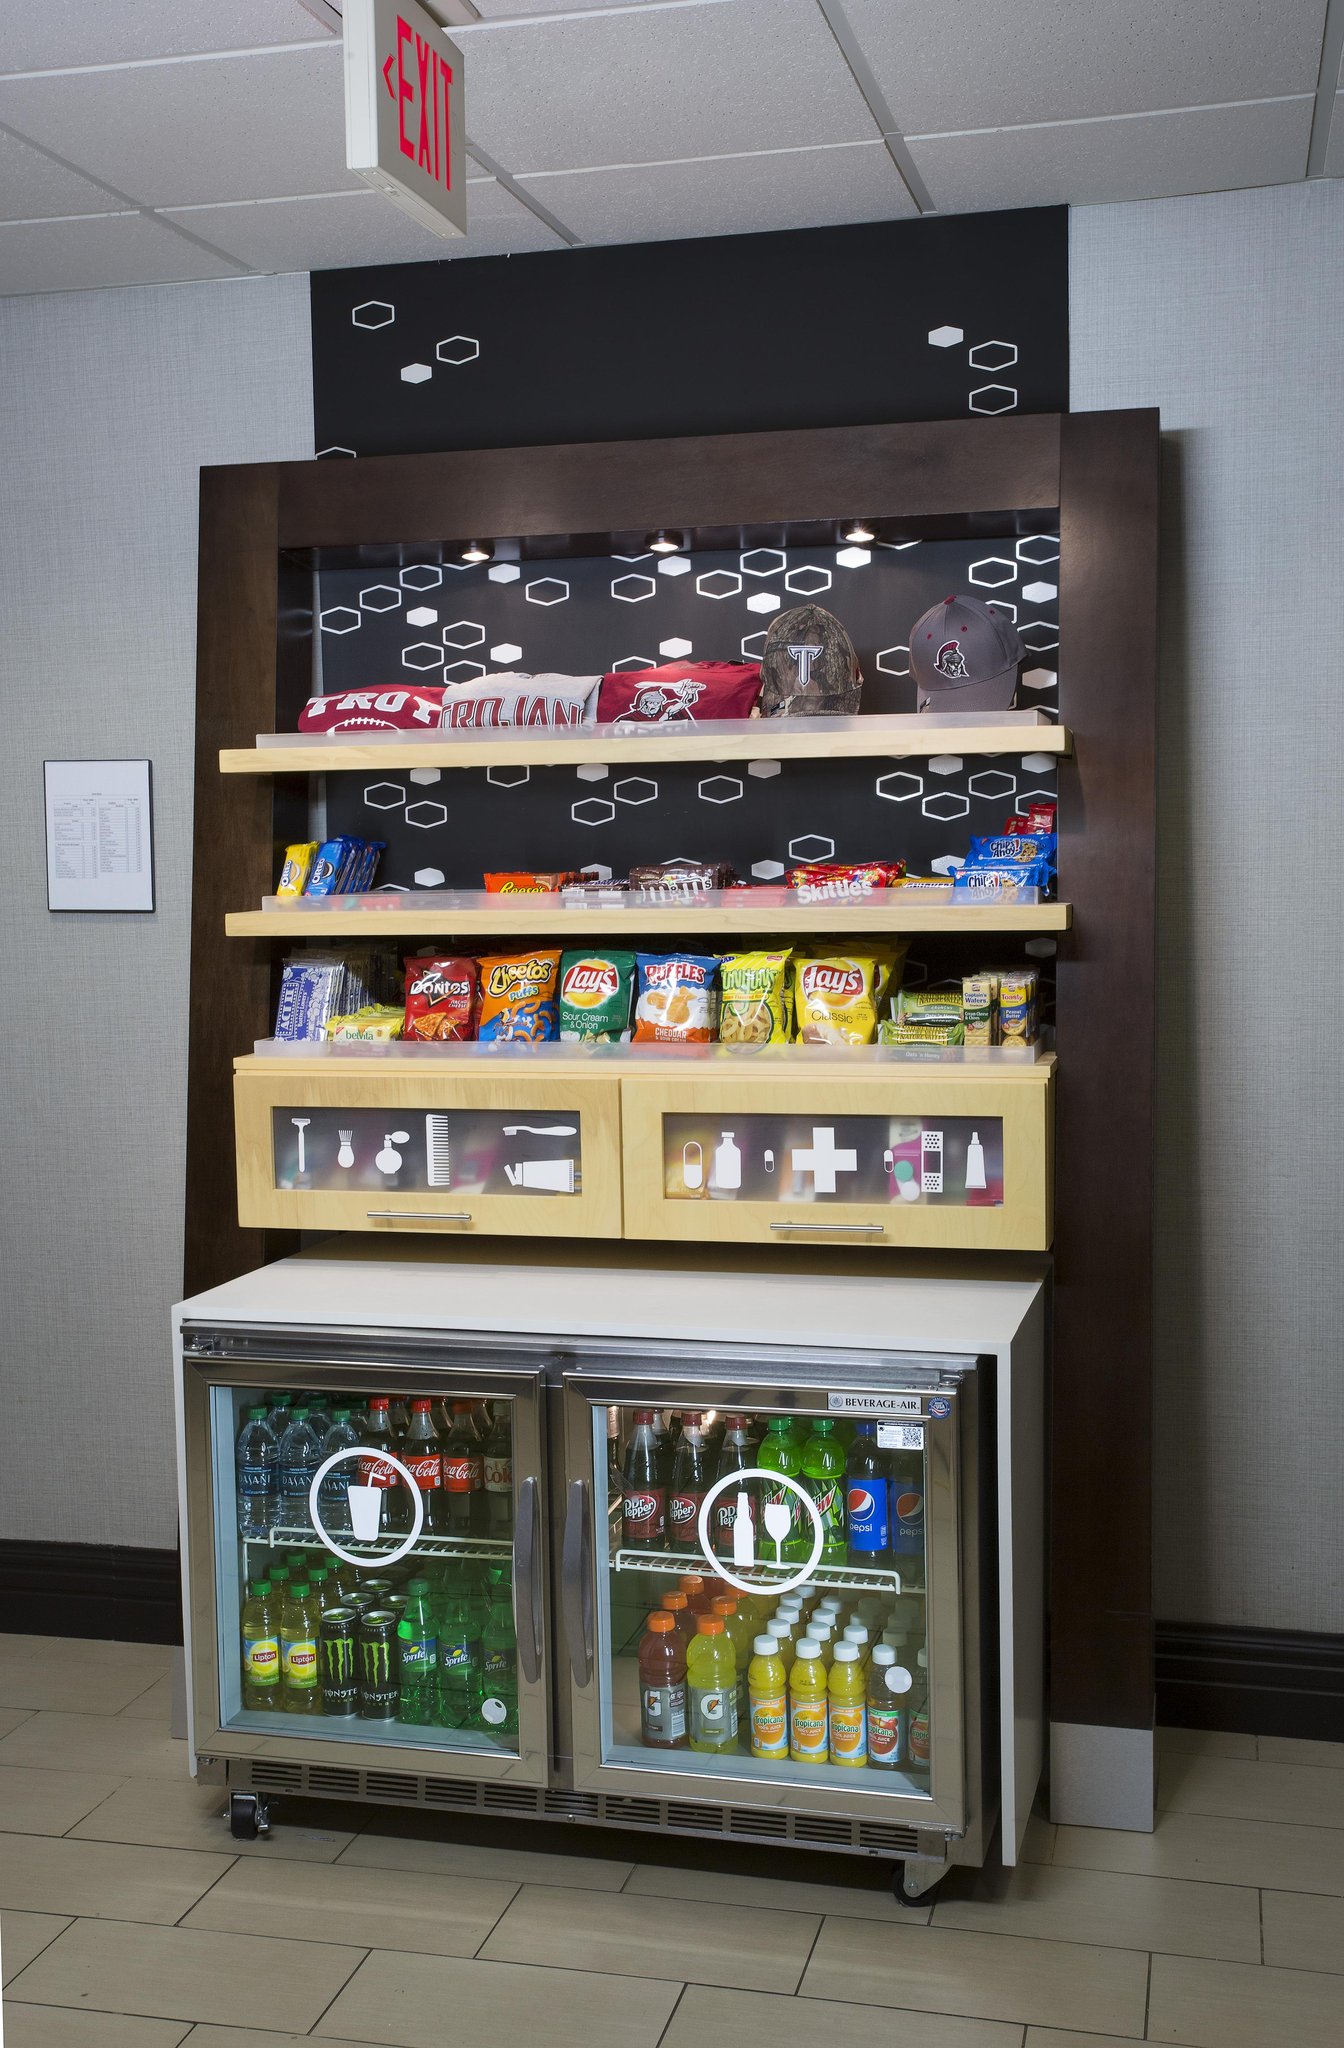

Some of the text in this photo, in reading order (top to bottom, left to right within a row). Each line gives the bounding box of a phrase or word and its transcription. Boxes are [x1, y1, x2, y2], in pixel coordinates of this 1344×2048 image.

[397, 15, 453, 192] EXIT
[305, 691, 442, 724] TROY
[991, 841, 1015, 851] Chips
[281, 860, 292, 887] OREO
[312, 858, 325, 884] OREO
[797, 880, 873, 904] Skittles
[489, 959, 551, 996] Cheetos
[645, 962, 706, 985] RUFFLES
[565, 967, 615, 993] Lay's
[805, 966, 860, 994] Lay's
[410, 979, 470, 995] Doritos
[509, 986, 538, 1001] Puffs
[281, 1005, 292, 1030] ACT
[562, 1012, 609, 1023] Sour Cream
[811, 1010, 853, 1024] Classic
[570, 1020, 599, 1029] & Onion
[346, 1030, 374, 1040] belvita
[655, 1027, 687, 1039] CHEDDAR
[402, 1459, 440, 1477] ca-Cola
[283, 1475, 313, 1486] DASAN
[322, 1479, 350, 1491] ASANI
[624, 1500, 654, 1519] Pepper
[850, 1523, 873, 1533] pepsi
[900, 1528, 923, 1537] peps
[254, 1652, 276, 1662] Lipton
[292, 1655, 314, 1664] Lipton
[403, 1650, 425, 1663] Sprite
[445, 1654, 468, 1666] Sprite
[484, 1661, 507, 1671] Sprite
[324, 1687, 358, 1698] ONSTE
[363, 1690, 399, 1701] ONSTER
[645, 1690, 661, 1716] G
[700, 1694, 723, 1720] G
[755, 1715, 784, 1725] Tropicana
[795, 1719, 824, 1728] Tropicana
[868, 1726, 893, 1737] opicana
